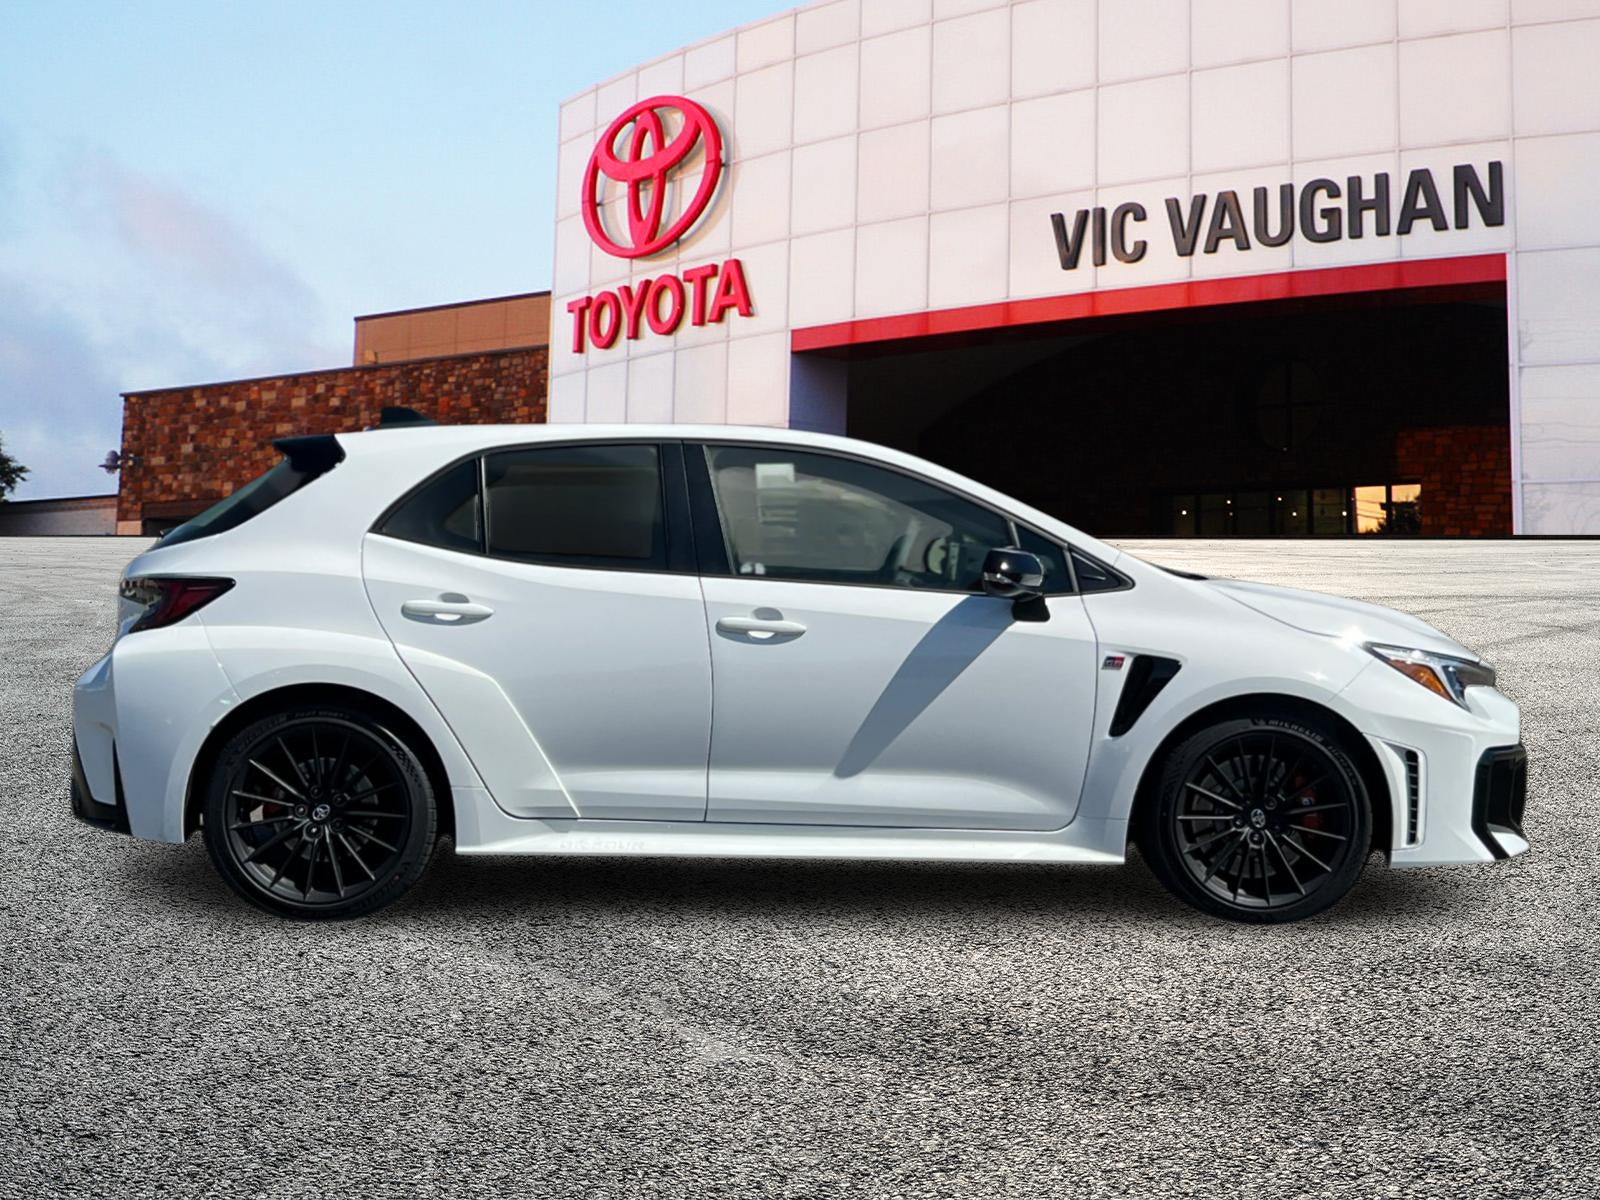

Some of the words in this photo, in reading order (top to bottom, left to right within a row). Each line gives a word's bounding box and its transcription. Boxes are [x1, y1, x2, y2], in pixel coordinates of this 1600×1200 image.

[1050, 201, 1147, 271] VIC
[1165, 161, 1505, 257] VAUGHAN
[567, 258, 753, 353] TOYOTA
